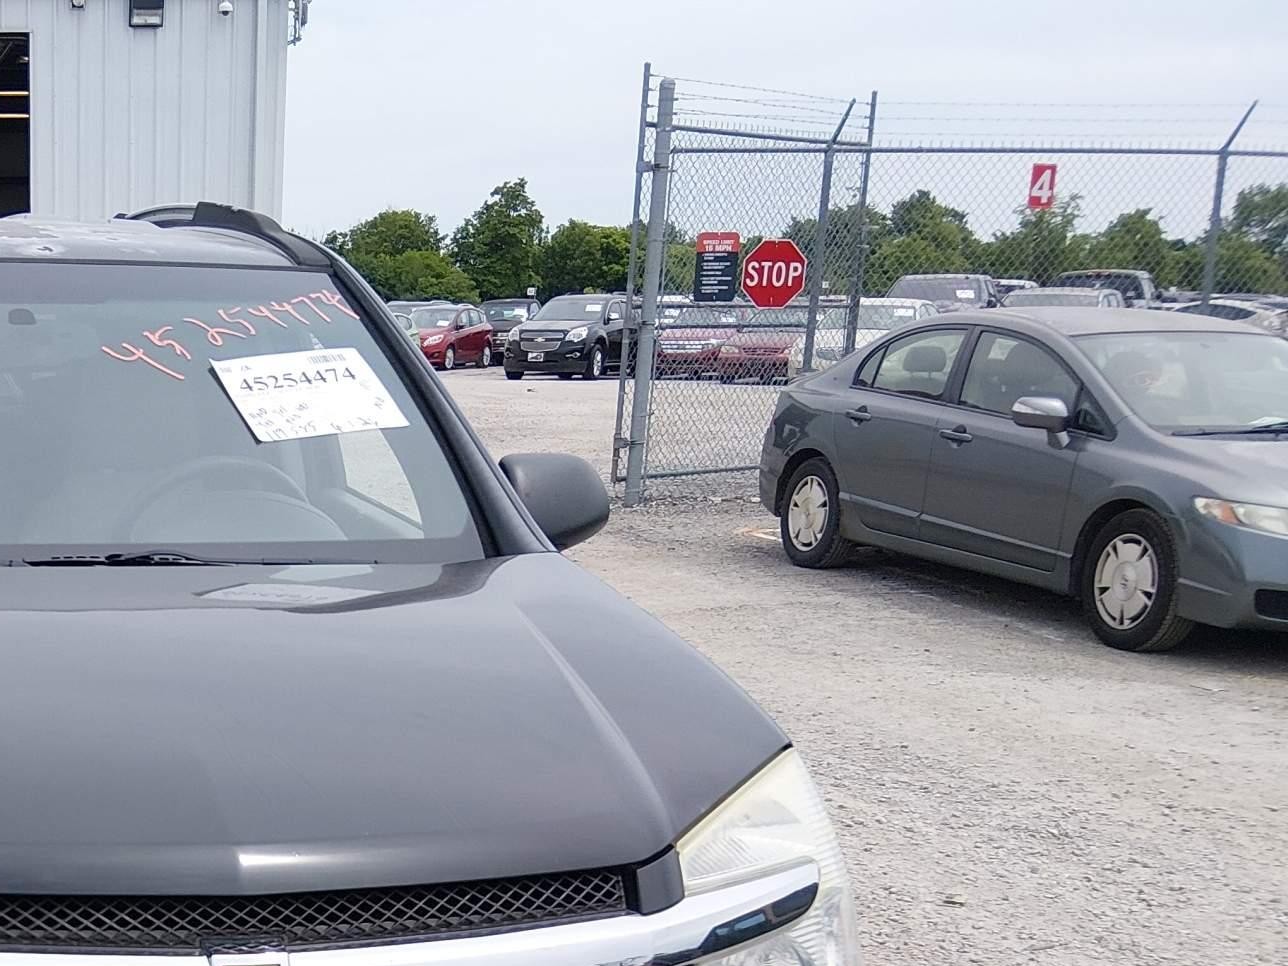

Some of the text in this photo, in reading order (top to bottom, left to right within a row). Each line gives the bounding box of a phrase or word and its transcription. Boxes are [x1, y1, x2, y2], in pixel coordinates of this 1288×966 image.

[1031, 169, 1053, 204] 4
[745, 261, 803, 287] STOP
[239, 366, 357, 392] 45254474
